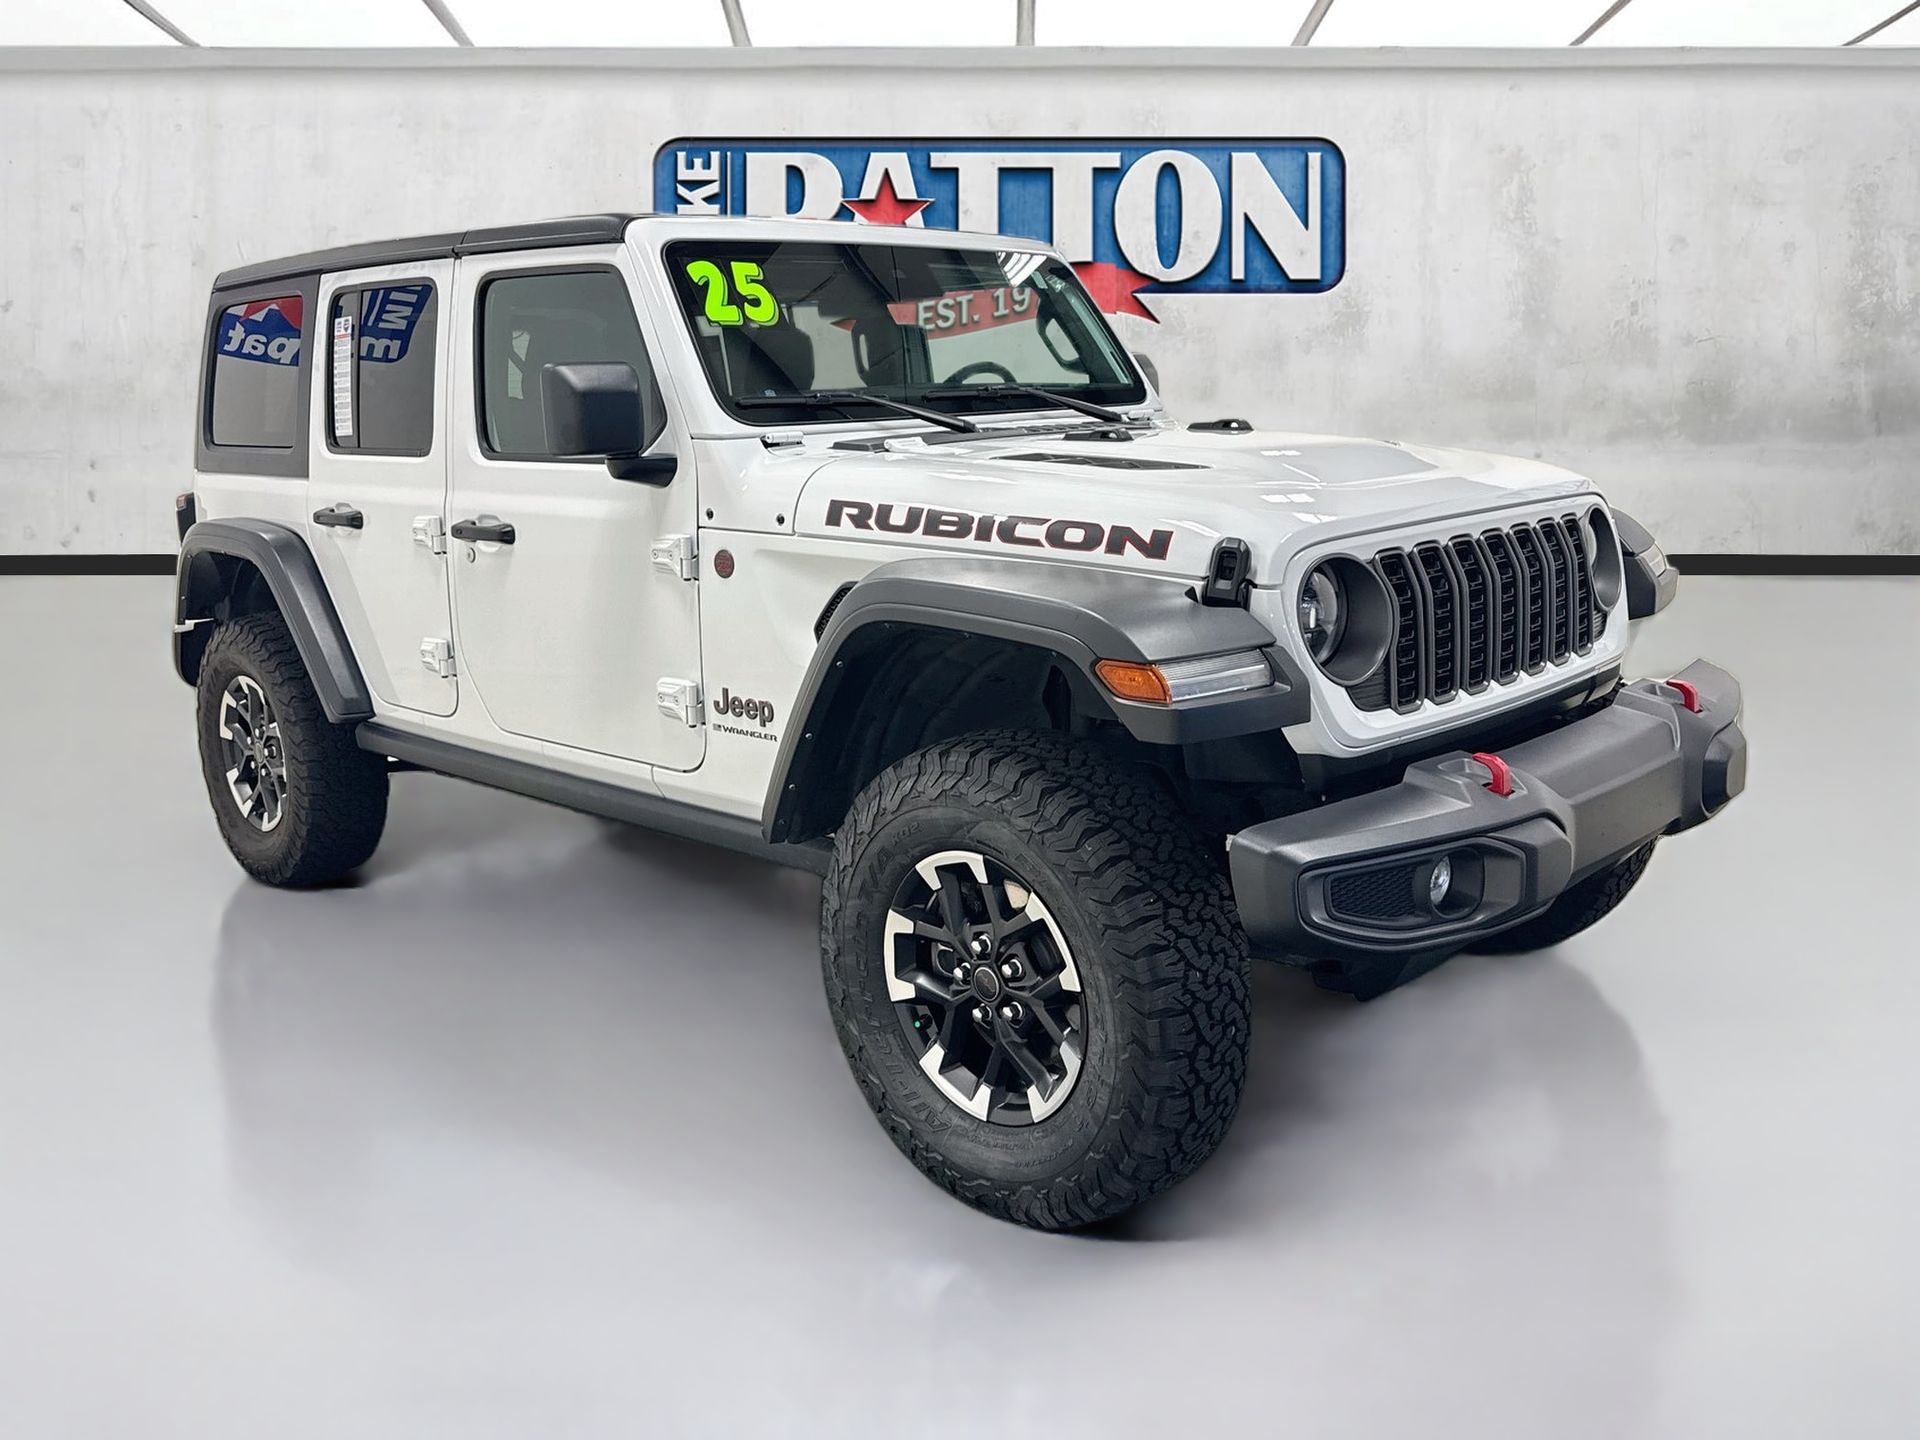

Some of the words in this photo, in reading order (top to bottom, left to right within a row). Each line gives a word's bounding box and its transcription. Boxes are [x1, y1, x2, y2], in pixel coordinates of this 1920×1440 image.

[686, 261, 780, 327] 25
[918, 293, 980, 331] EST.
[824, 498, 1174, 561] RUBICON
[713, 687, 775, 727] Jeep
[722, 724, 778, 742] WRANGLER
